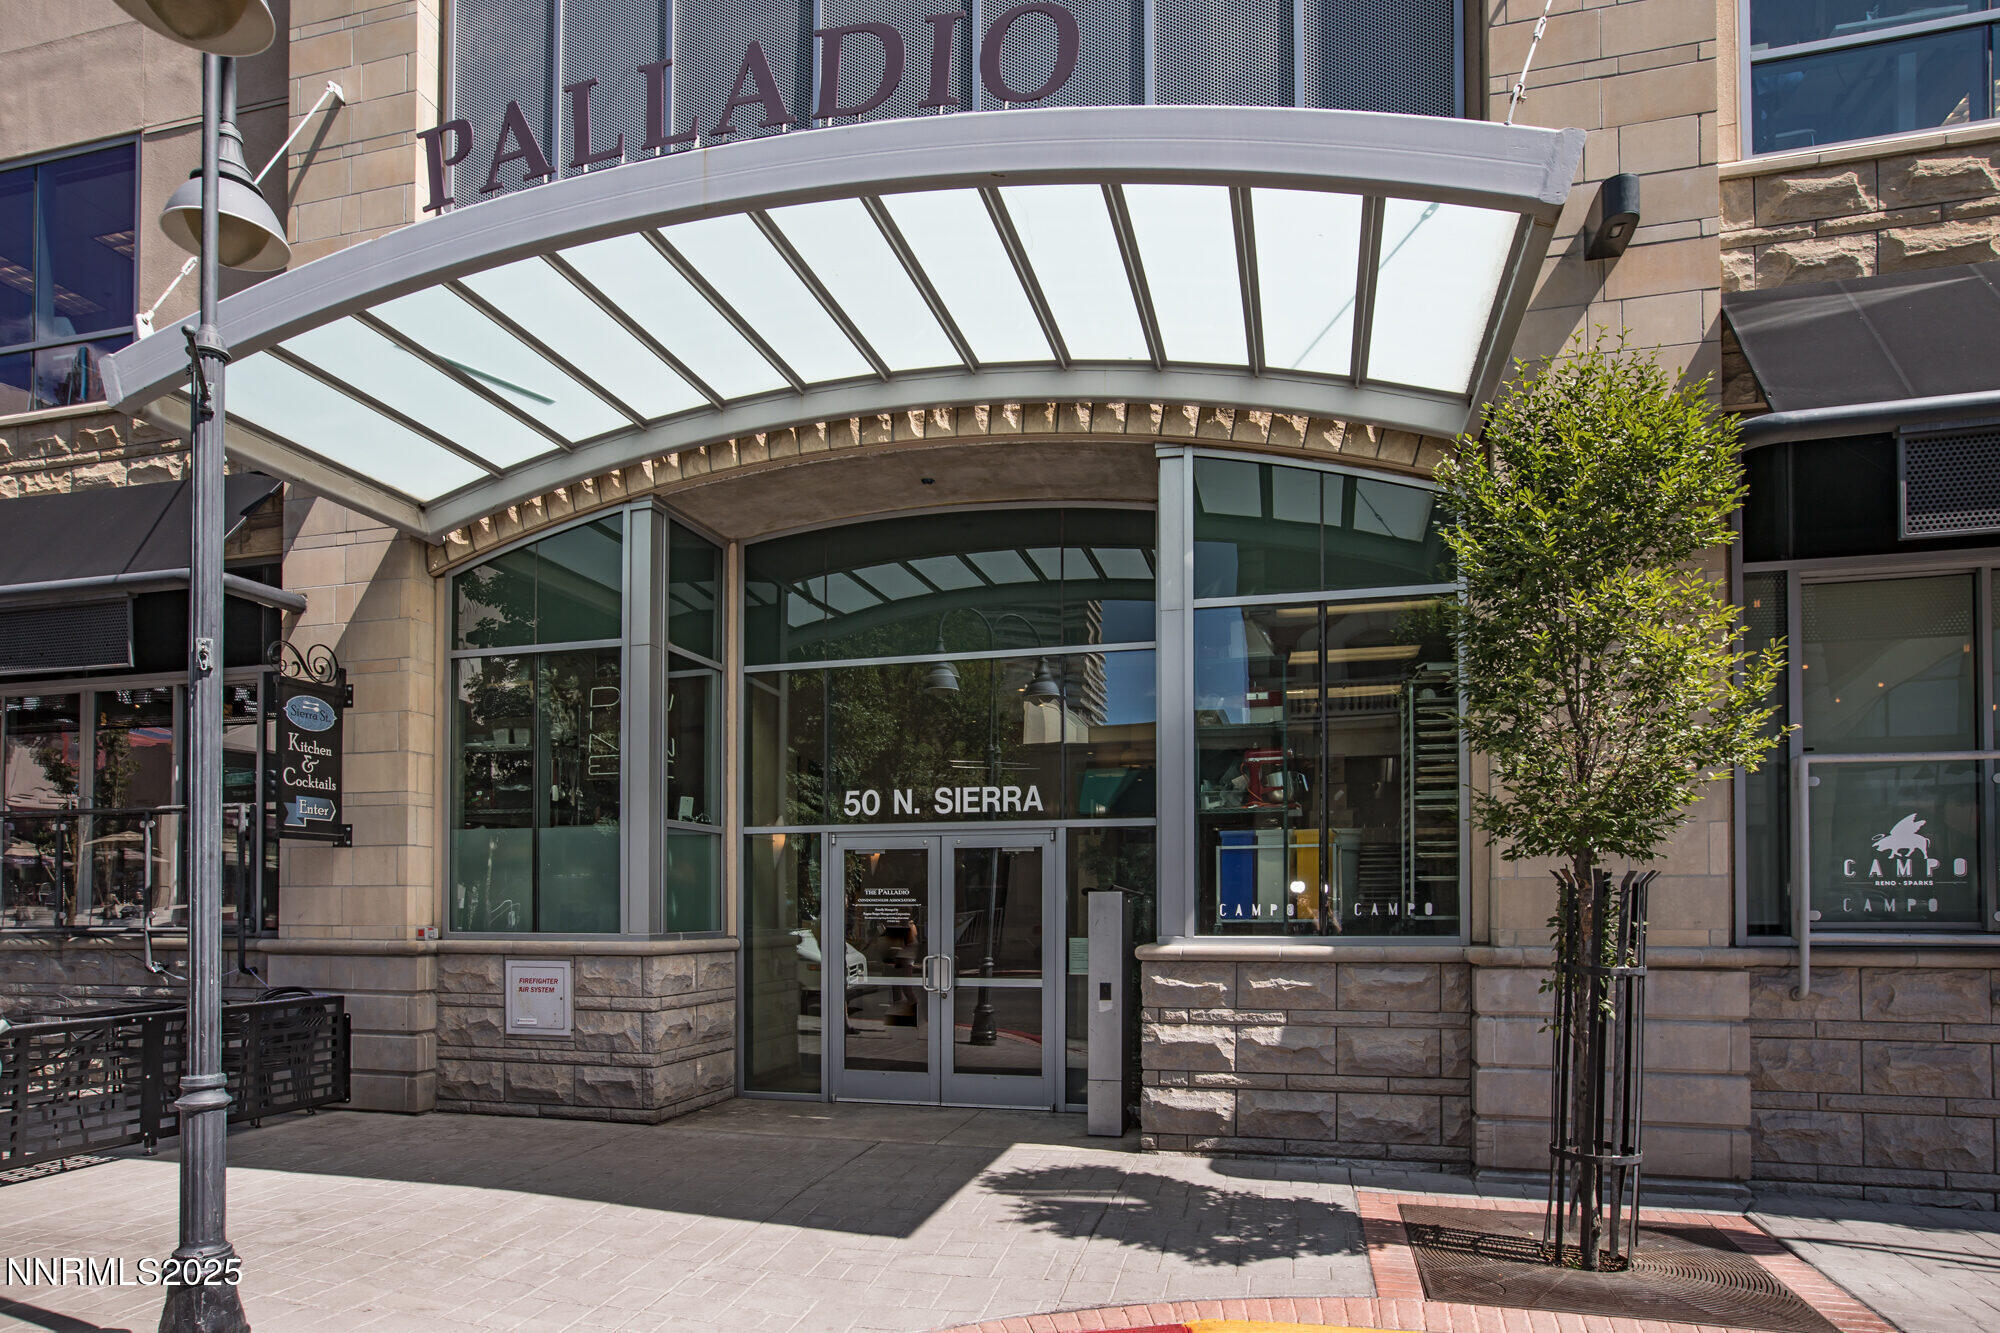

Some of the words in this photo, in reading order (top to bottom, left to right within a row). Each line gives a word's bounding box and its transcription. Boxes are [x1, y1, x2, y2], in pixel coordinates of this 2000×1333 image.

[417, 2, 1080, 212] PALLADIO
[290, 704, 318, 720] Sierra
[288, 732, 332, 756] Kitchen
[301, 755, 320, 773] &
[283, 766, 337, 791] Cocktails
[299, 799, 329, 816] Enter
[843, 789, 881, 816] 50
[893, 788, 920, 815] N.
[934, 785, 1044, 814] SIERRA
[1842, 858, 1968, 878] CAMPO
[1219, 903, 1295, 917] CAMPO
[1353, 902, 1433, 916] CAMPO
[1842, 898, 1938, 912] CAMPO
